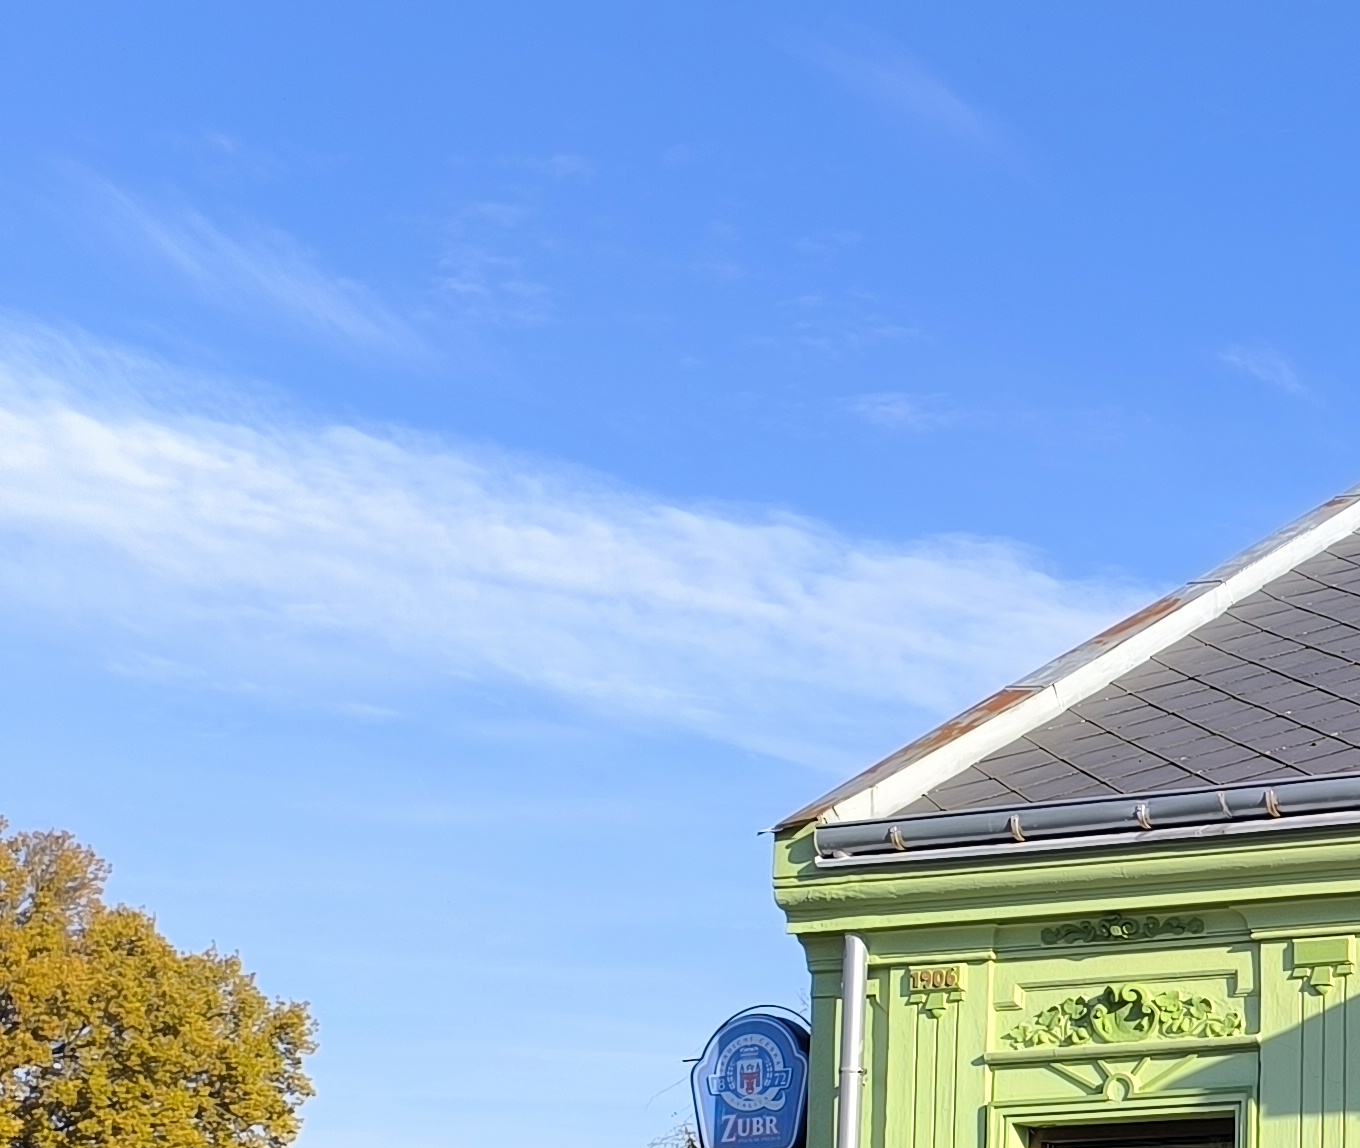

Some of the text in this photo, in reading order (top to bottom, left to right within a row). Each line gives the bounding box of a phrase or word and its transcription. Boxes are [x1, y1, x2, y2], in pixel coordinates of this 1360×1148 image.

[910, 967, 957, 989] 1906
[713, 1077, 726, 1092] 18
[773, 1072, 787, 1086] 72
[720, 1114, 779, 1143] ZUBR
